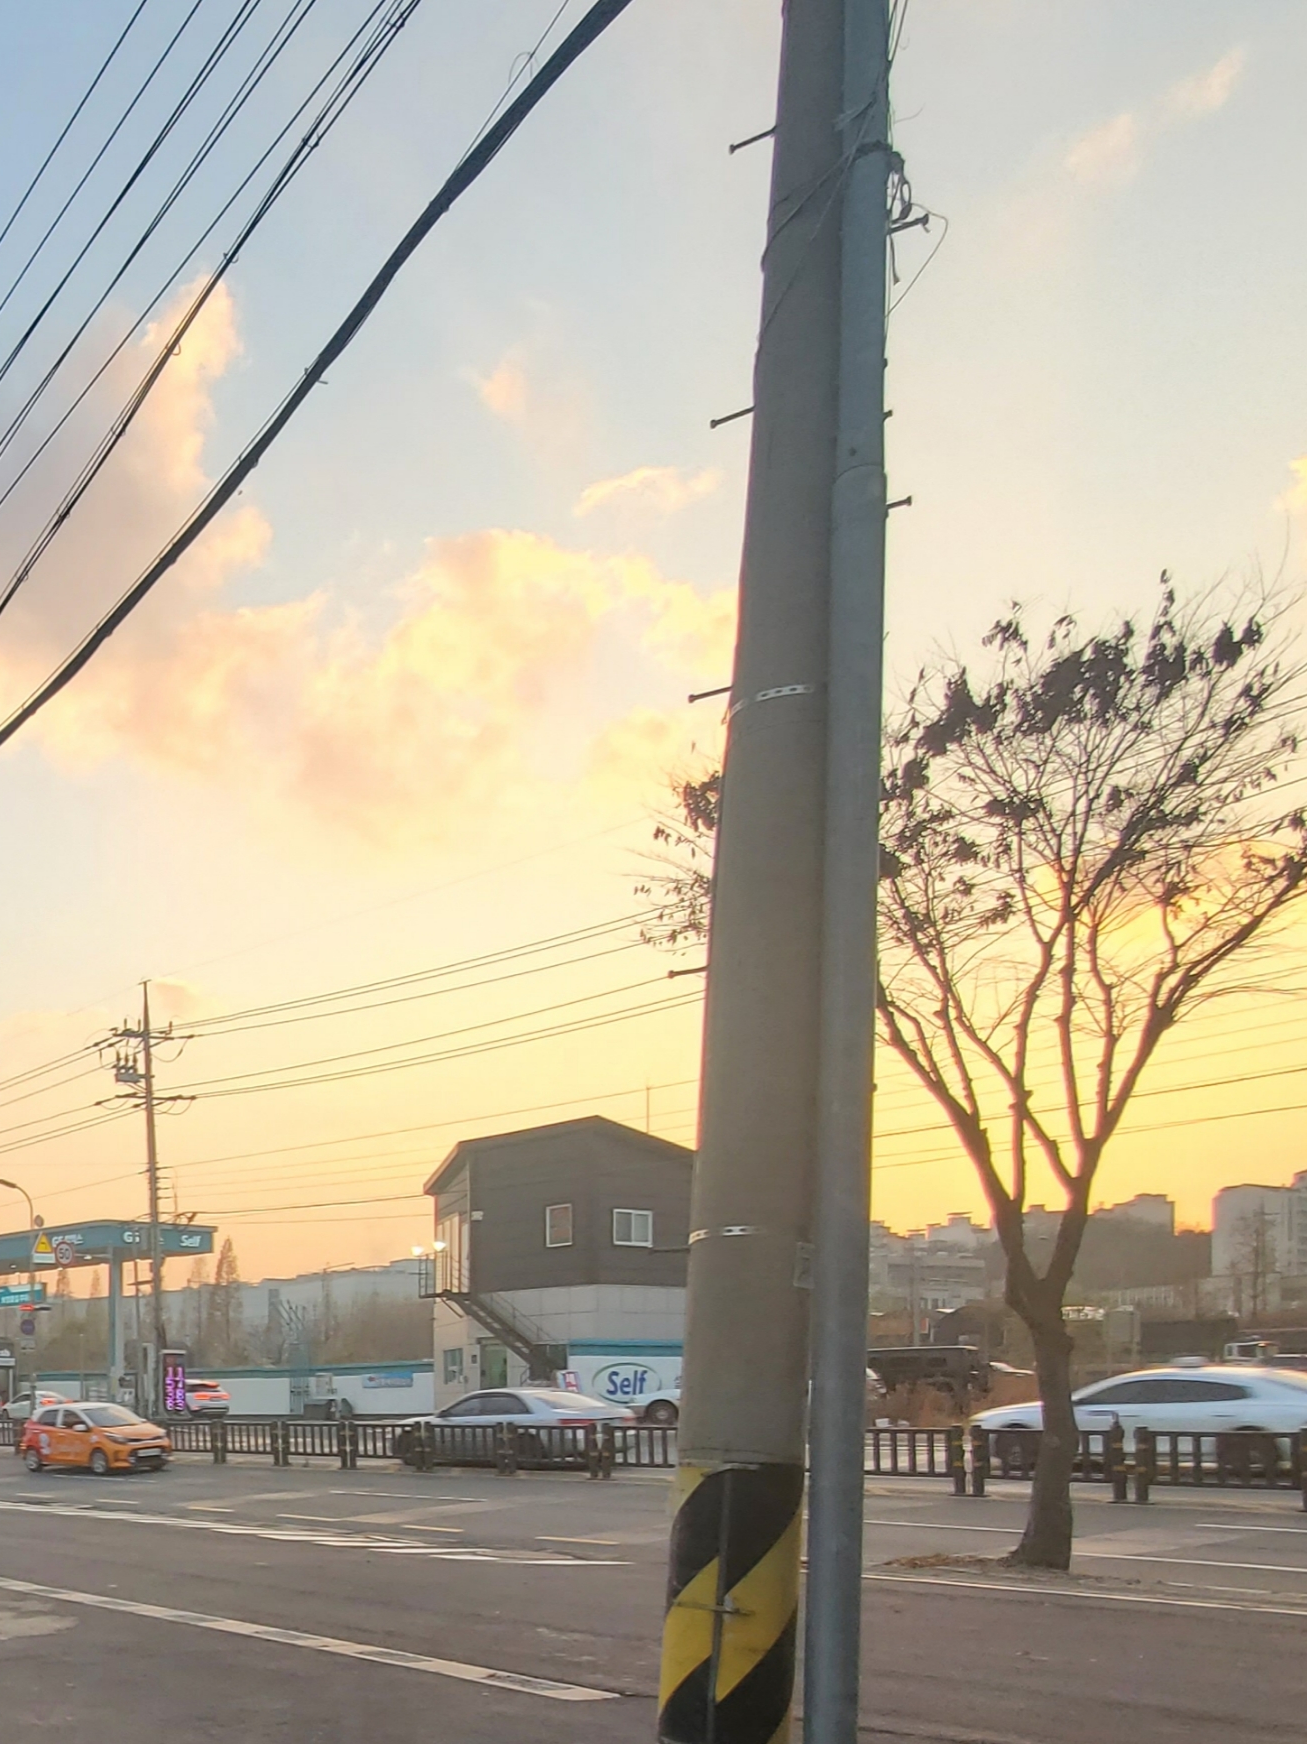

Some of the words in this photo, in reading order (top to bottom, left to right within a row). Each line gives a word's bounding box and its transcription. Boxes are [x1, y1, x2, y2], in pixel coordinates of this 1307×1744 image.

[179, 1234, 202, 1248] Self
[58, 1247, 70, 1260] 50
[606, 1369, 648, 1396] Self
